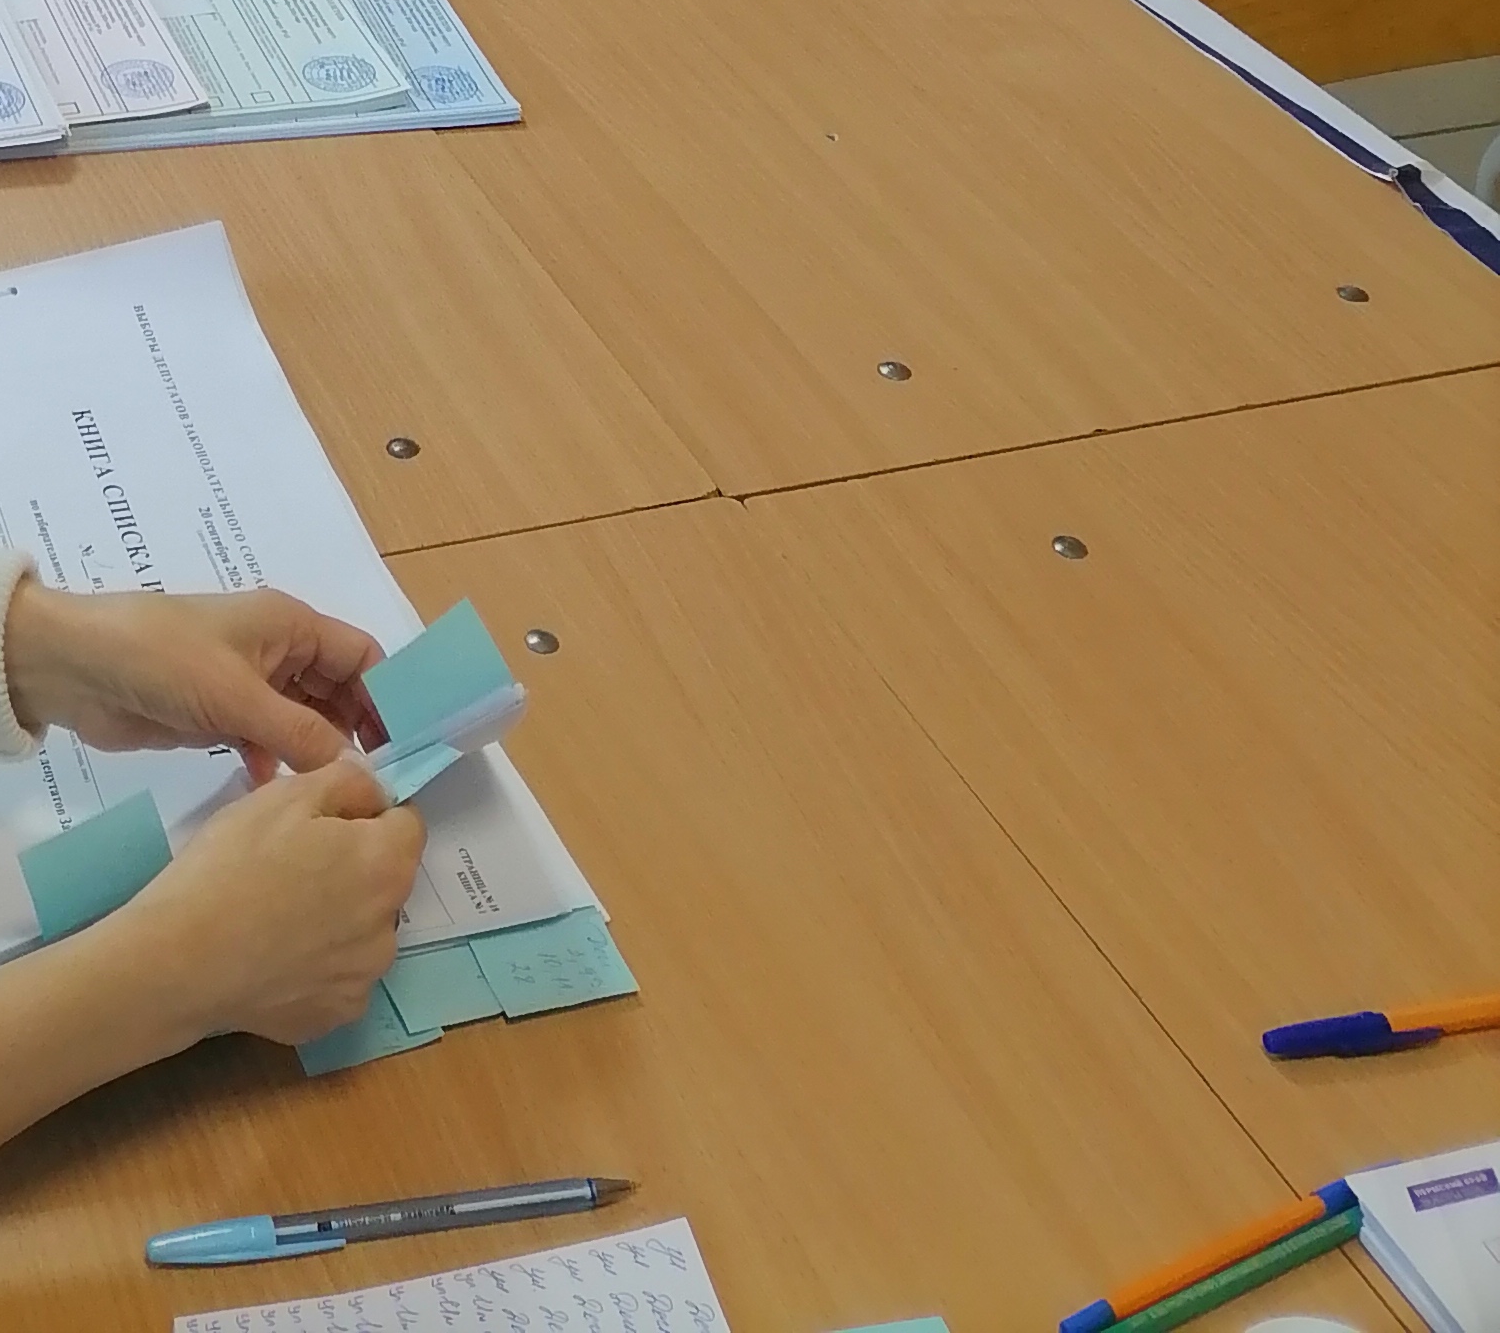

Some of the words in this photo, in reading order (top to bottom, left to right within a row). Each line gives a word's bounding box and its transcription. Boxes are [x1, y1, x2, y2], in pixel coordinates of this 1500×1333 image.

[72, 409, 115, 480] КНИГА
[102, 484, 154, 575] СПИСКА
[140, 579, 166, 593] И
[133, 304, 161, 353] ВЫБОРЫ
[152, 355, 190, 421] ДЕПУТАТОВ
[182, 422, 247, 542] ЗАКОНОДАТЕЛЬНОГО
[240, 544, 269, 590] СОБРА
[204, 519, 231, 565] сентября
[225, 565, 245, 589] 2026
[39, 758, 66, 816] депутатов
[59, 817, 73, 833] За
